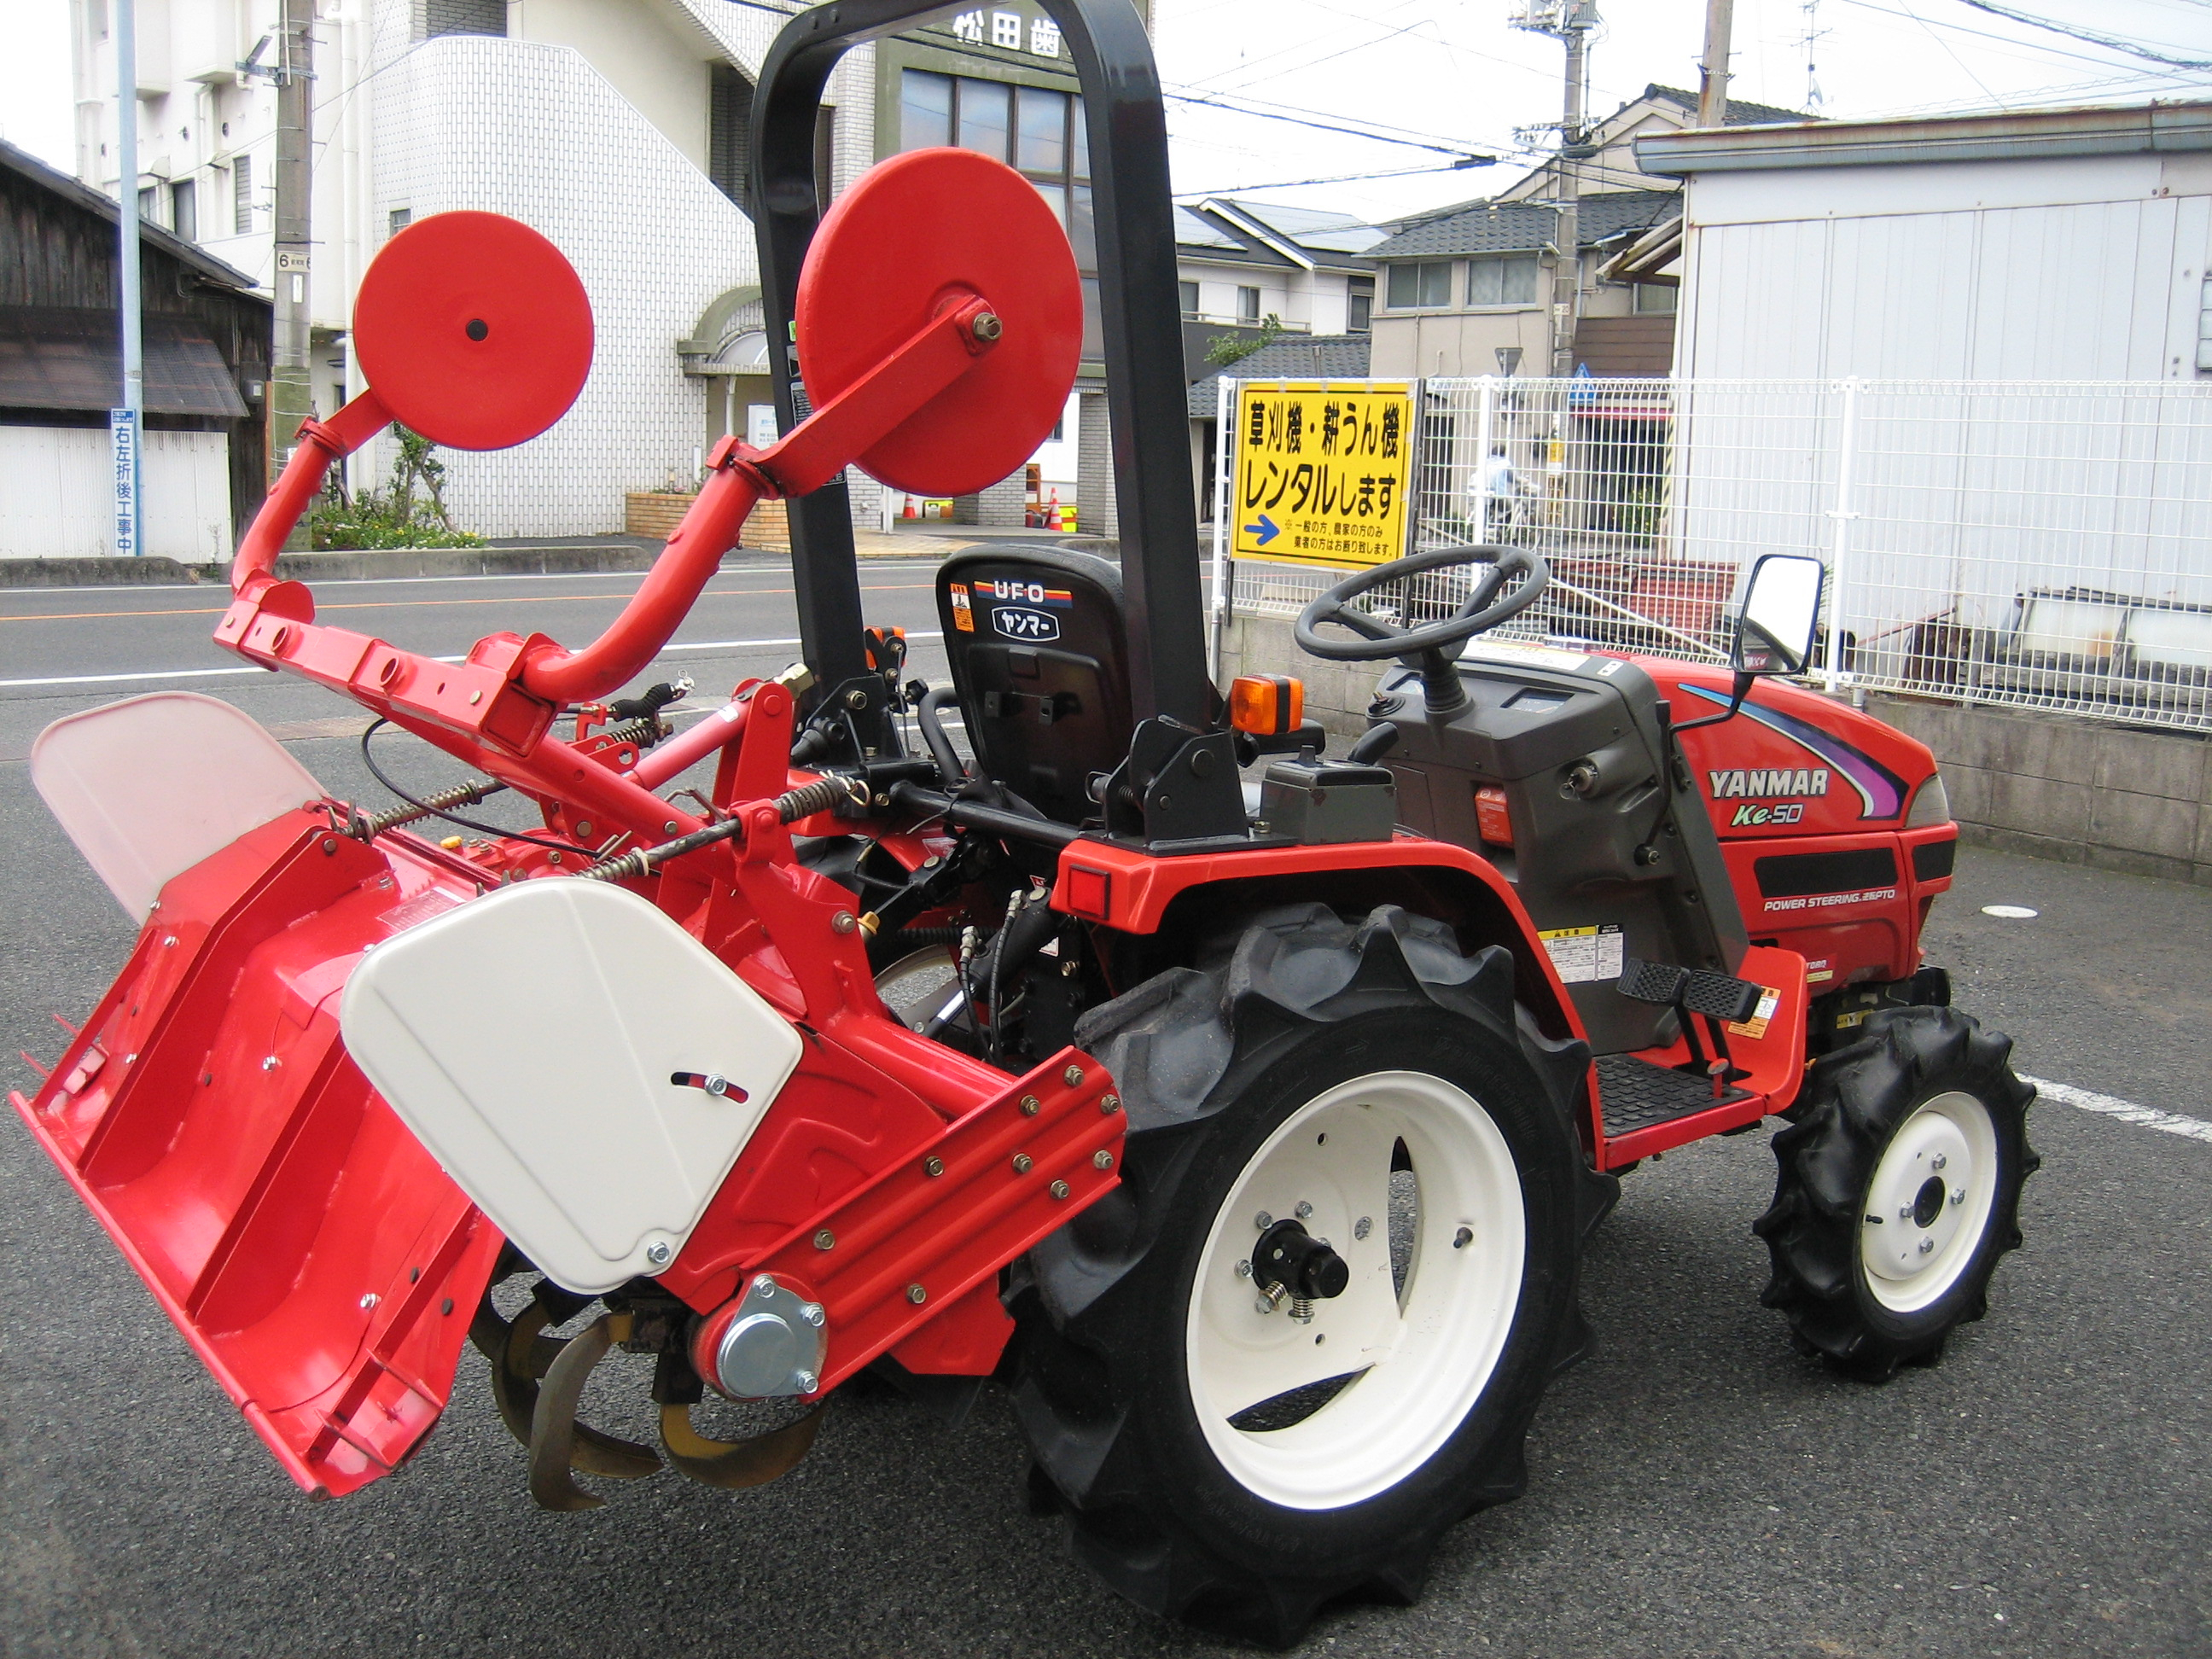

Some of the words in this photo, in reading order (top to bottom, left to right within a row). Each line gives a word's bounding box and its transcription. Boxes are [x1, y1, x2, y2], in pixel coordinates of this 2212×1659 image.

[1249, 399, 1400, 459] 草刈機・耕うん機
[115, 426, 132, 555] 右左折後工事中
[1245, 458, 1397, 521] レンタルします
[993, 579, 1045, 603] UFO
[1000, 610, 1051, 637] ヤンマー
[1708, 768, 1829, 799] YANMAR
[1763, 899, 1806, 912] POWER
